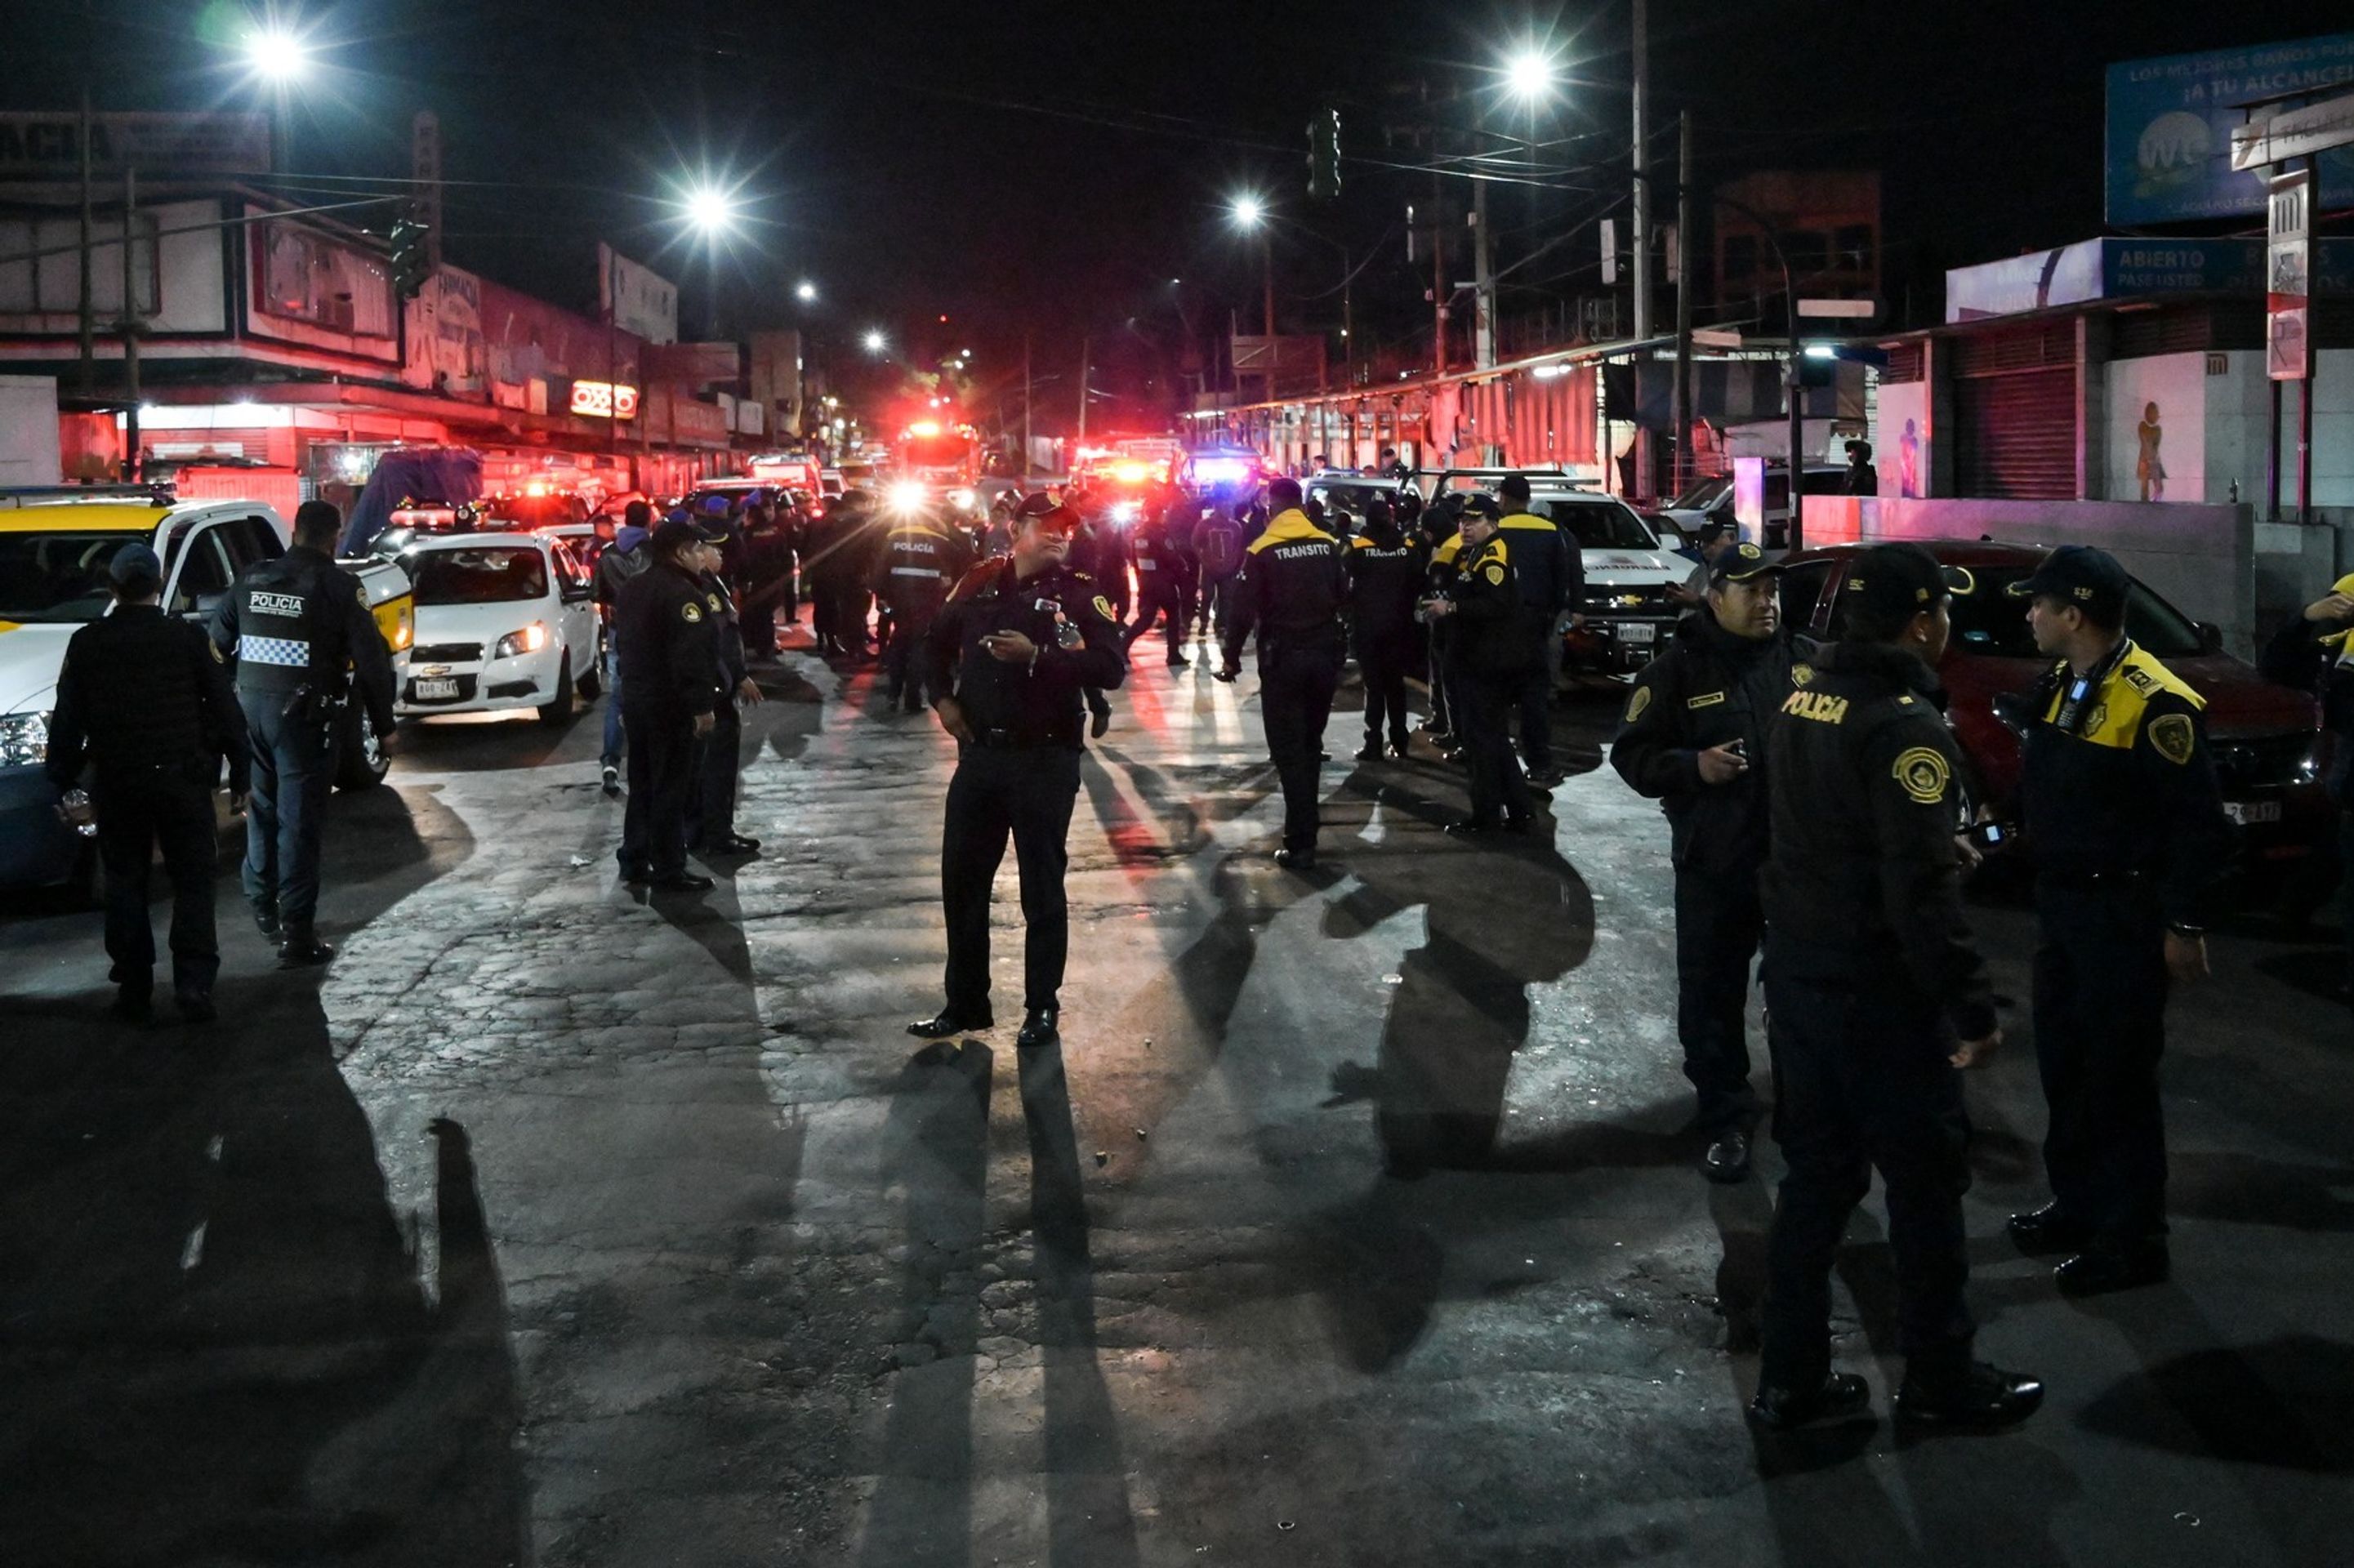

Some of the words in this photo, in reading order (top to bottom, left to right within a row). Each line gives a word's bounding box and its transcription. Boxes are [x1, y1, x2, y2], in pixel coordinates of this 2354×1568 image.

[2210, 78, 2239, 97] TU
[2119, 249, 2206, 268] ABIERTO
[573, 387, 632, 413] OXXO
